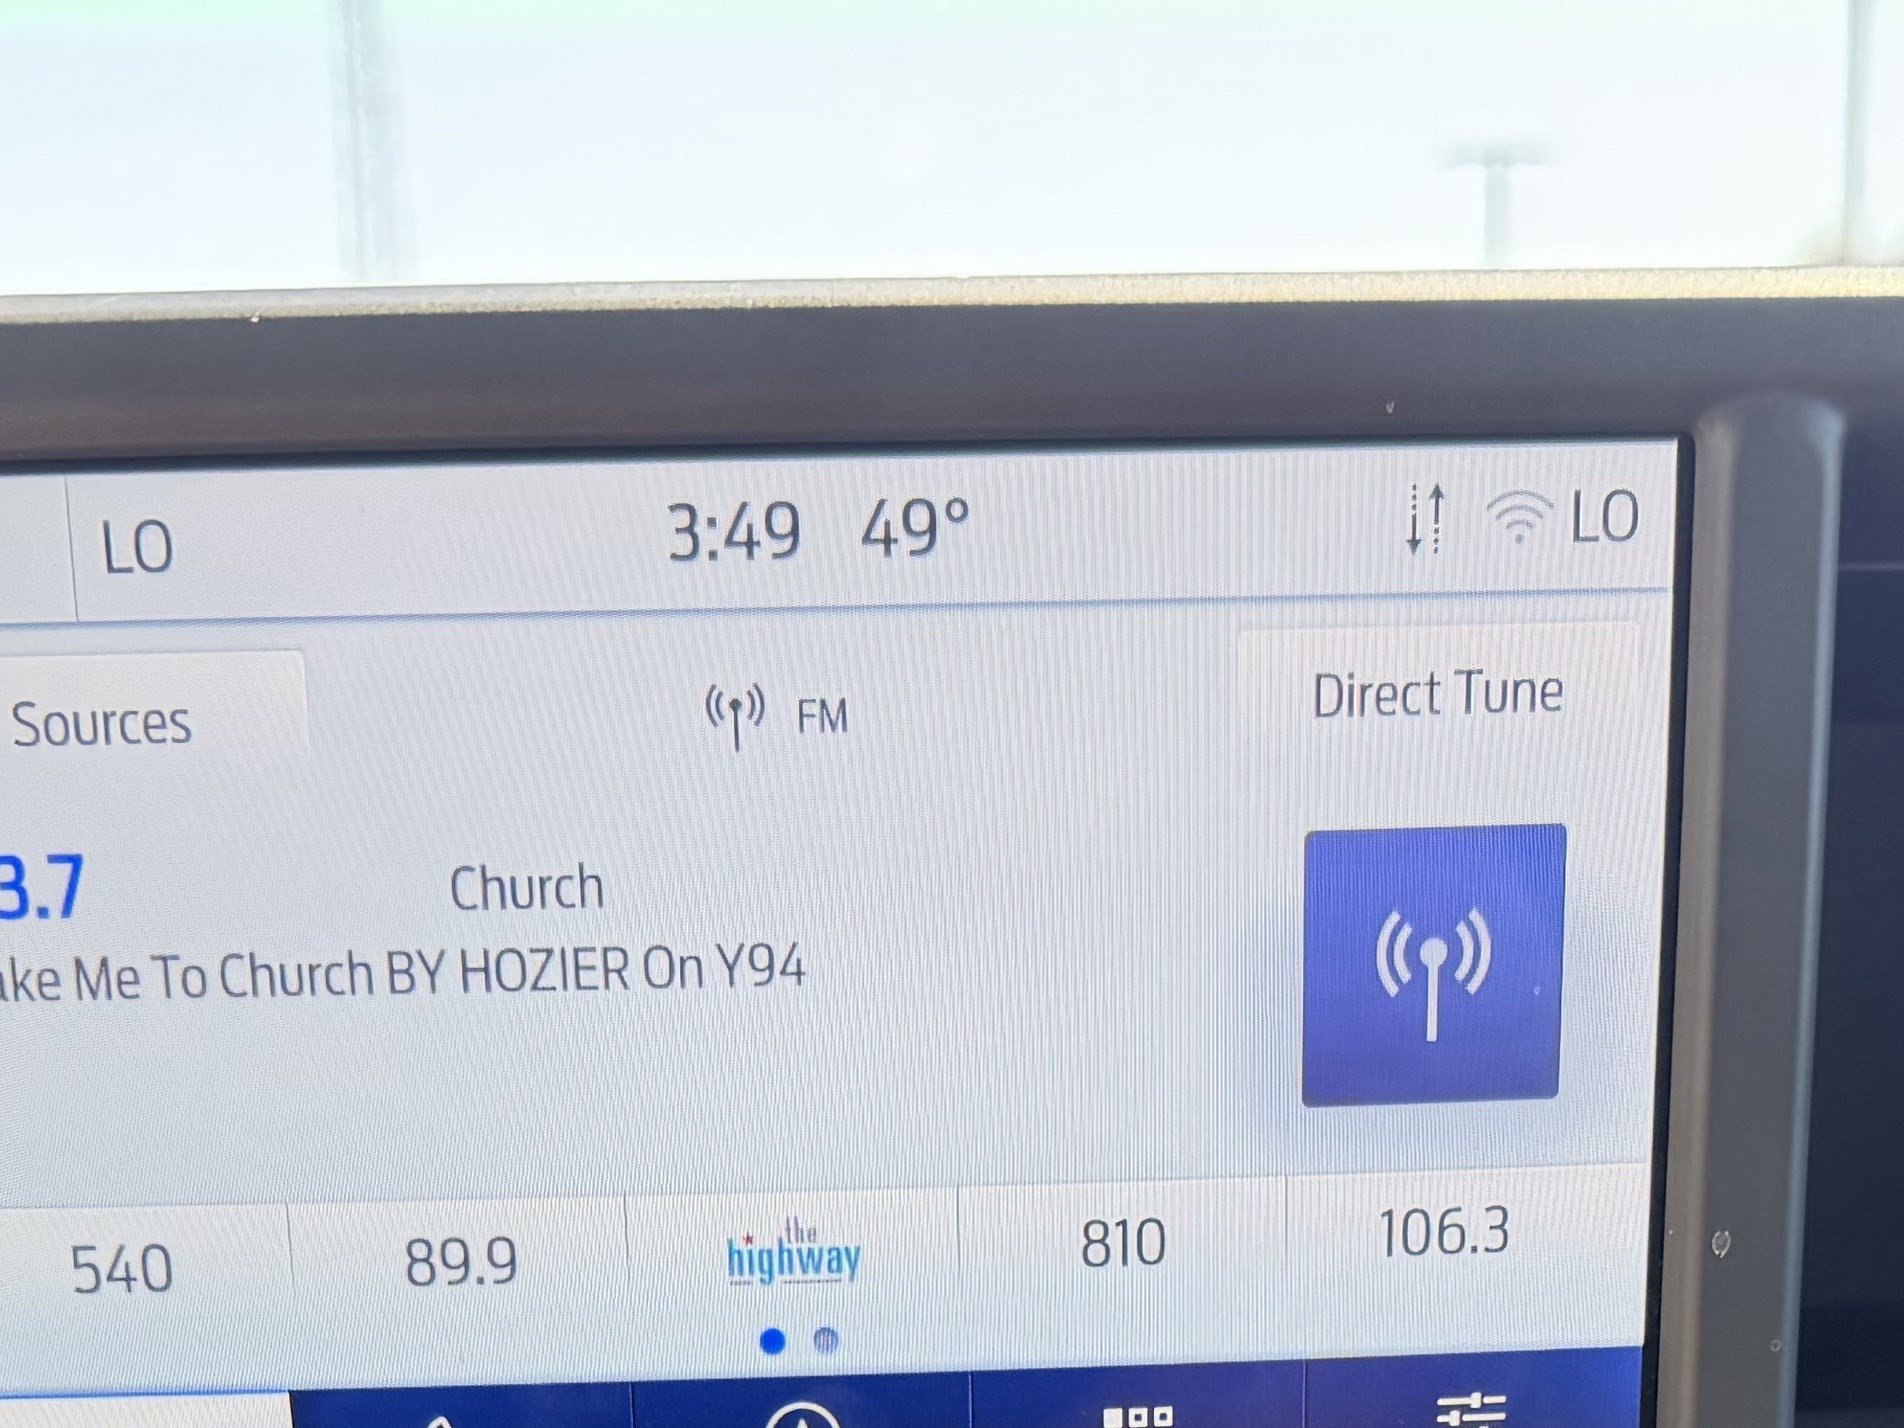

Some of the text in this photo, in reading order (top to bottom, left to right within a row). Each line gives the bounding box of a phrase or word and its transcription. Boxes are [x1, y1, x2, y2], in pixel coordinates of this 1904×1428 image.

[667, 501, 802, 563] 3:49
[1572, 488, 1640, 544] LO
[101, 519, 174, 575] LO
[797, 699, 848, 735] FM
[1314, 667, 1564, 720] Direct Tune
[11, 700, 193, 747] Sources
[450, 864, 604, 912] Church
[74, 956, 141, 1000] Me
[150, 954, 208, 998] To
[219, 951, 375, 997] Church
[387, 950, 444, 993] BY
[459, 945, 630, 992] HOZIER
[643, 946, 703, 990] On
[716, 942, 805, 988] Y94
[785, 1214, 817, 1244] the
[1081, 1218, 1166, 1268] 810
[1380, 1206, 1510, 1258] 106.3
[70, 1246, 173, 1294] 540
[406, 1238, 518, 1286] 89.9
[727, 1235, 861, 1286] highway
